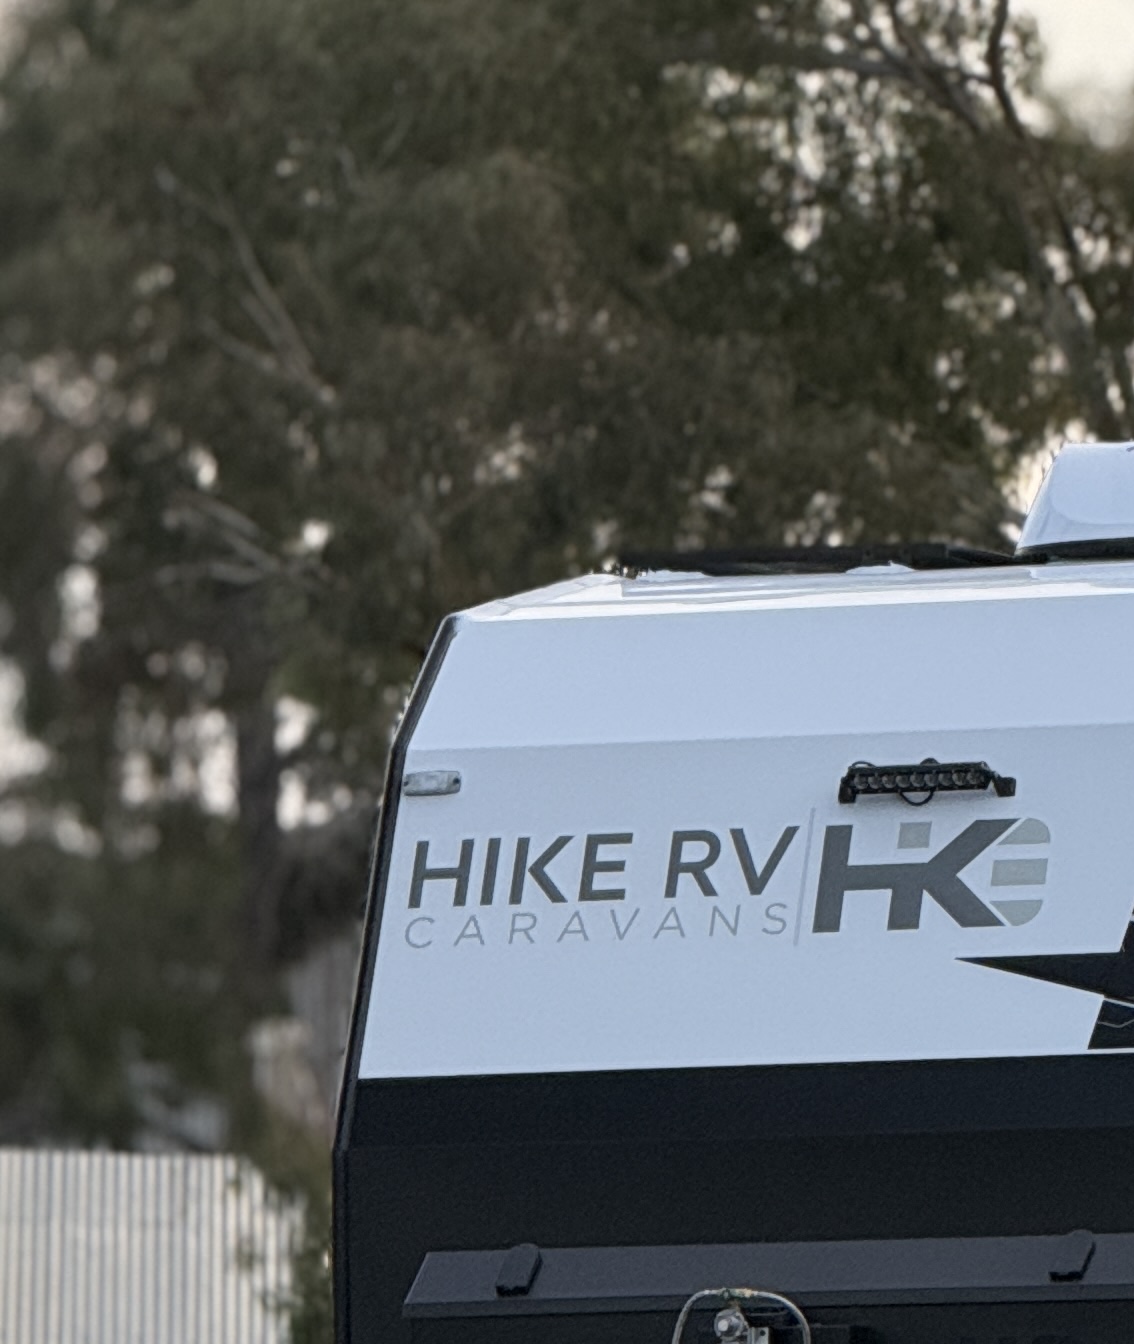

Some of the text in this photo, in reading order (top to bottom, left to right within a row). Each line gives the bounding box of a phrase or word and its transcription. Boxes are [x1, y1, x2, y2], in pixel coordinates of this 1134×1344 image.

[407, 832, 632, 910] HIKE
[664, 824, 801, 899] RV
[403, 902, 788, 950] CARAVANS
